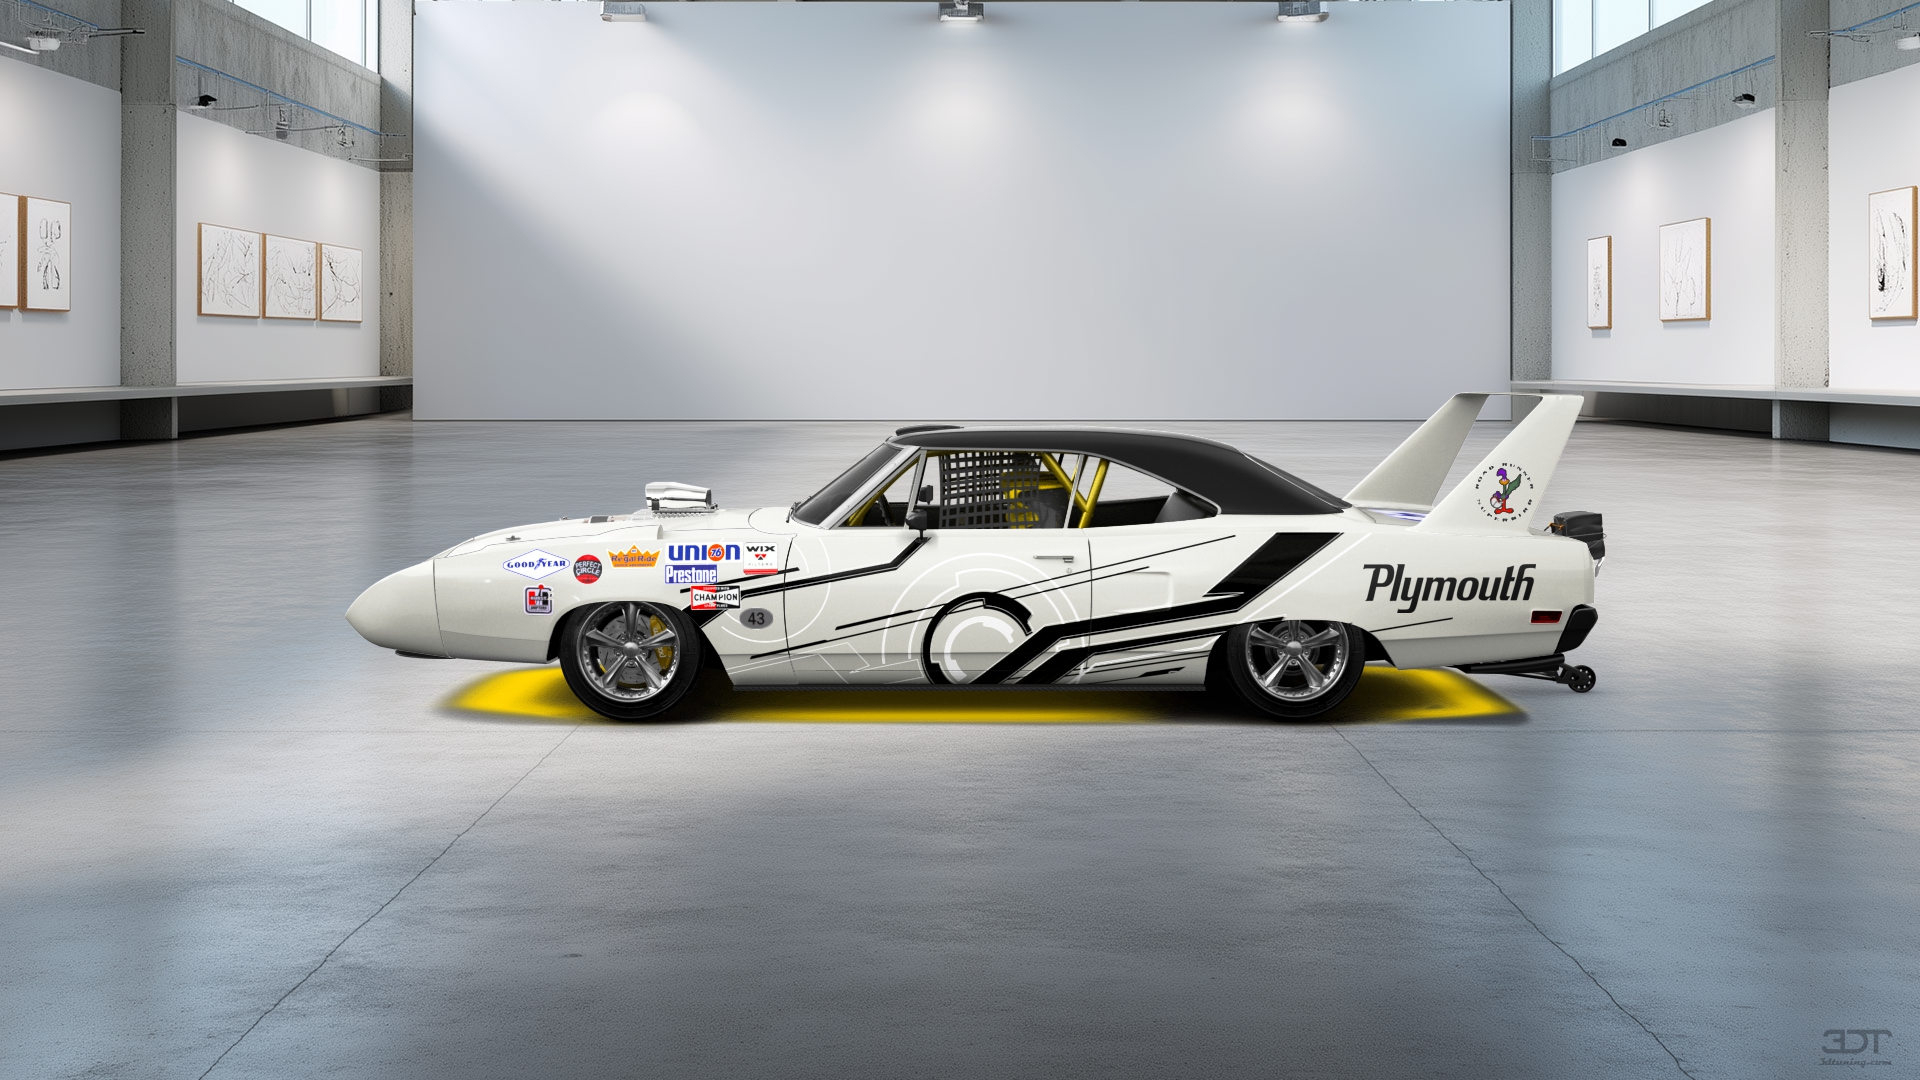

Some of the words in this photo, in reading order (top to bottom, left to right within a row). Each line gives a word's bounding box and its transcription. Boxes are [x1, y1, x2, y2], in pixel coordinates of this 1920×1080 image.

[709, 548, 722, 557] 76
[575, 560, 601, 569] PERFECT
[575, 567, 600, 576] CIRCLE
[665, 565, 717, 583] Prestone
[1363, 564, 1536, 613] Plymouth
[694, 593, 738, 601] CHAMPION
[747, 612, 765, 625] 43
